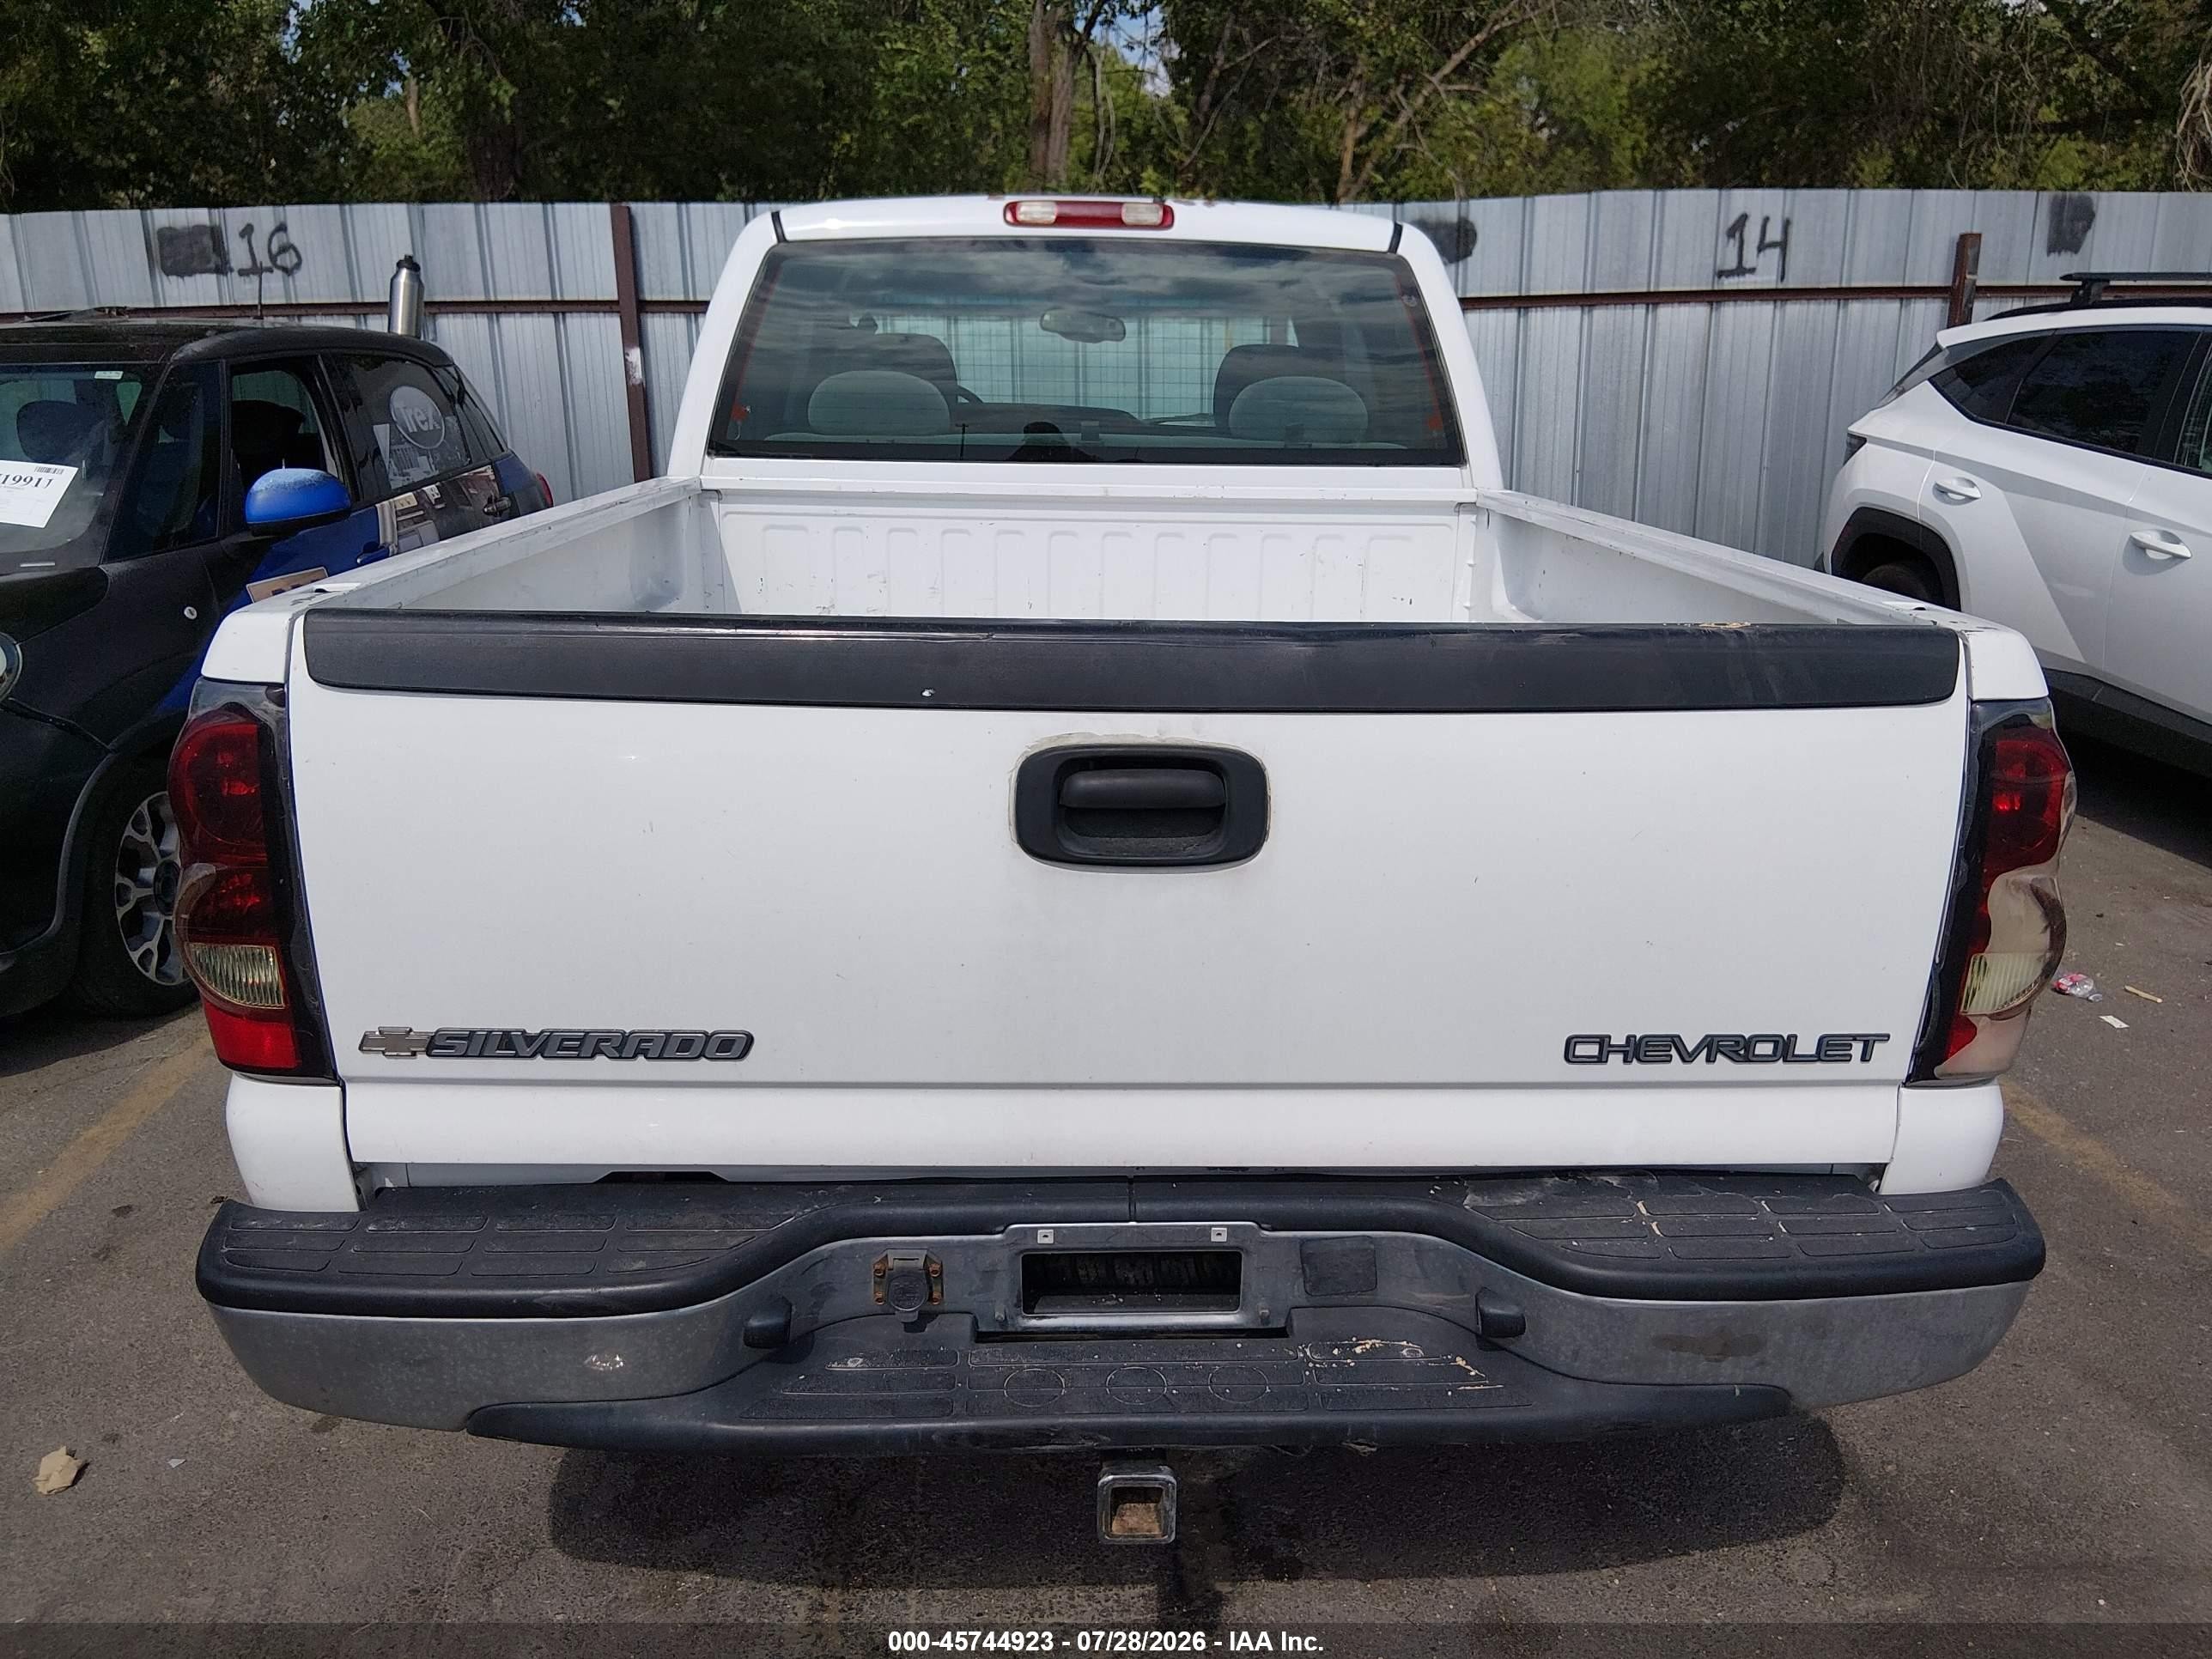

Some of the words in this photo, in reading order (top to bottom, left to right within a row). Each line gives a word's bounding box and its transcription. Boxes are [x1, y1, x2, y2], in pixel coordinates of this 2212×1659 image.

[238, 223, 302, 276] 16
[1716, 213, 1790, 283] 14
[428, 1028, 754, 1060] SILVERADO
[1565, 1033, 1890, 1064] CHEVROLET
